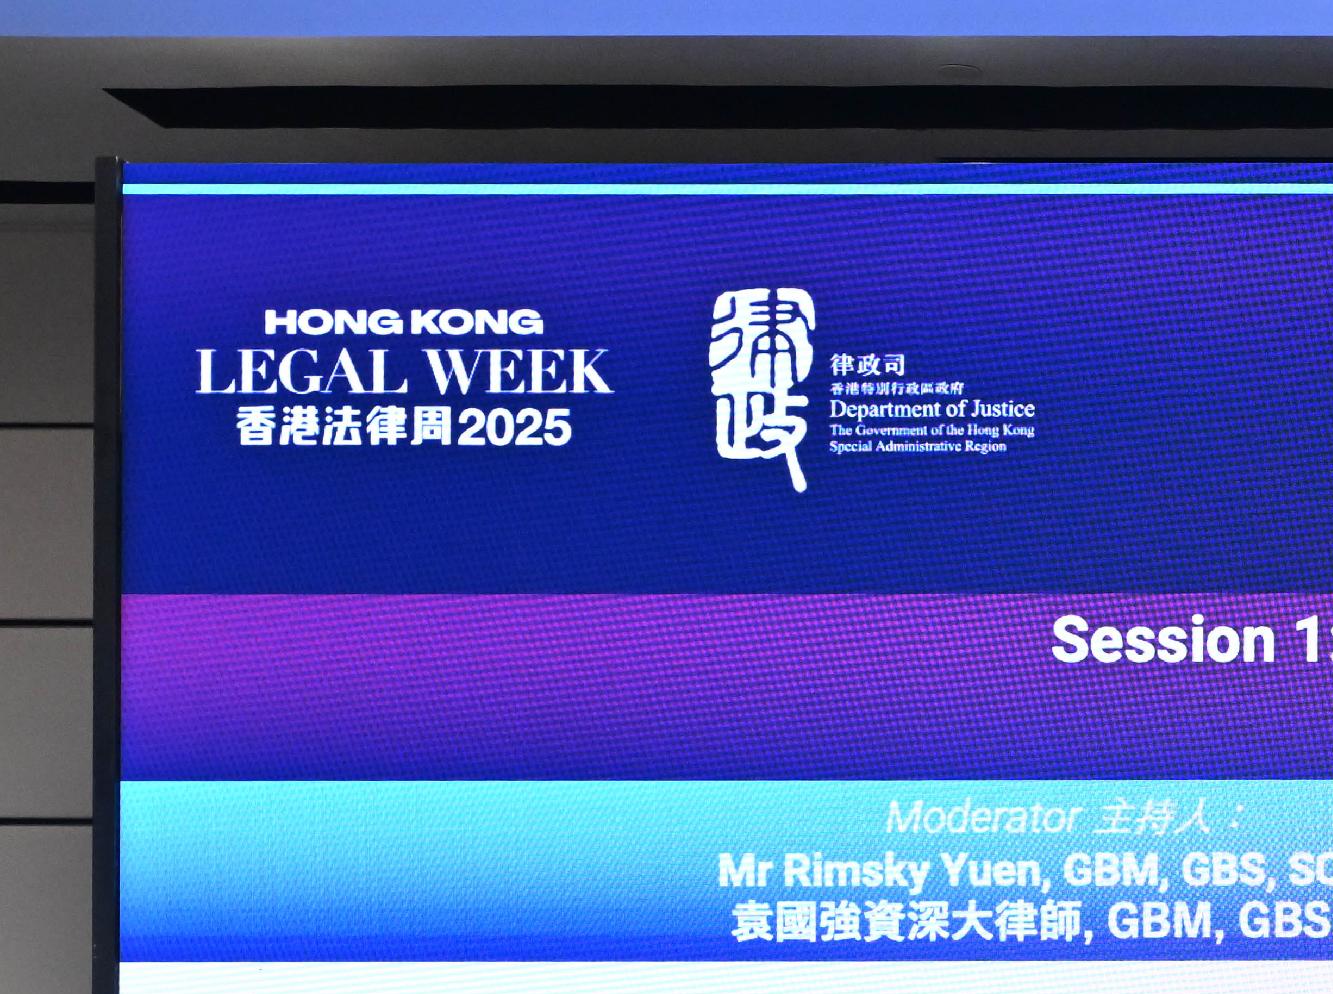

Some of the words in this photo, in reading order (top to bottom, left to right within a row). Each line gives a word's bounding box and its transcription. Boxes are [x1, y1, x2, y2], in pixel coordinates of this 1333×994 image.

[265, 308, 404, 335] HONG
[410, 308, 544, 335] KONG
[196, 347, 408, 395] LEGAL
[424, 348, 613, 395] WEEK
[829, 352, 905, 376] 律政司
[236, 405, 572, 446] 香港法律周2025
[829, 400, 941, 422] Department
[946, 399, 968, 418] of
[971, 399, 1036, 418] Justice
[829, 424, 852, 436] The
[855, 424, 927, 436] Government
[931, 424, 945, 435] of
[946, 424, 965, 436] the
[967, 424, 999, 438] Hong
[1002, 424, 1036, 438] Kong
[829, 439, 872, 454] Special
[875, 440, 962, 453] Administrative
[964, 440, 1008, 455] Region
[1052, 613, 1275, 663] Session
[886, 800, 1082, 834] Moderator
[719, 853, 773, 887] Mr
[784, 851, 930, 895] Rimsky
[941, 852, 1051, 894] Yuen,
[1064, 852, 1168, 892] GBM,
[1182, 851, 1276, 893] GBS,
[1108, 900, 1224, 945] GBM,
